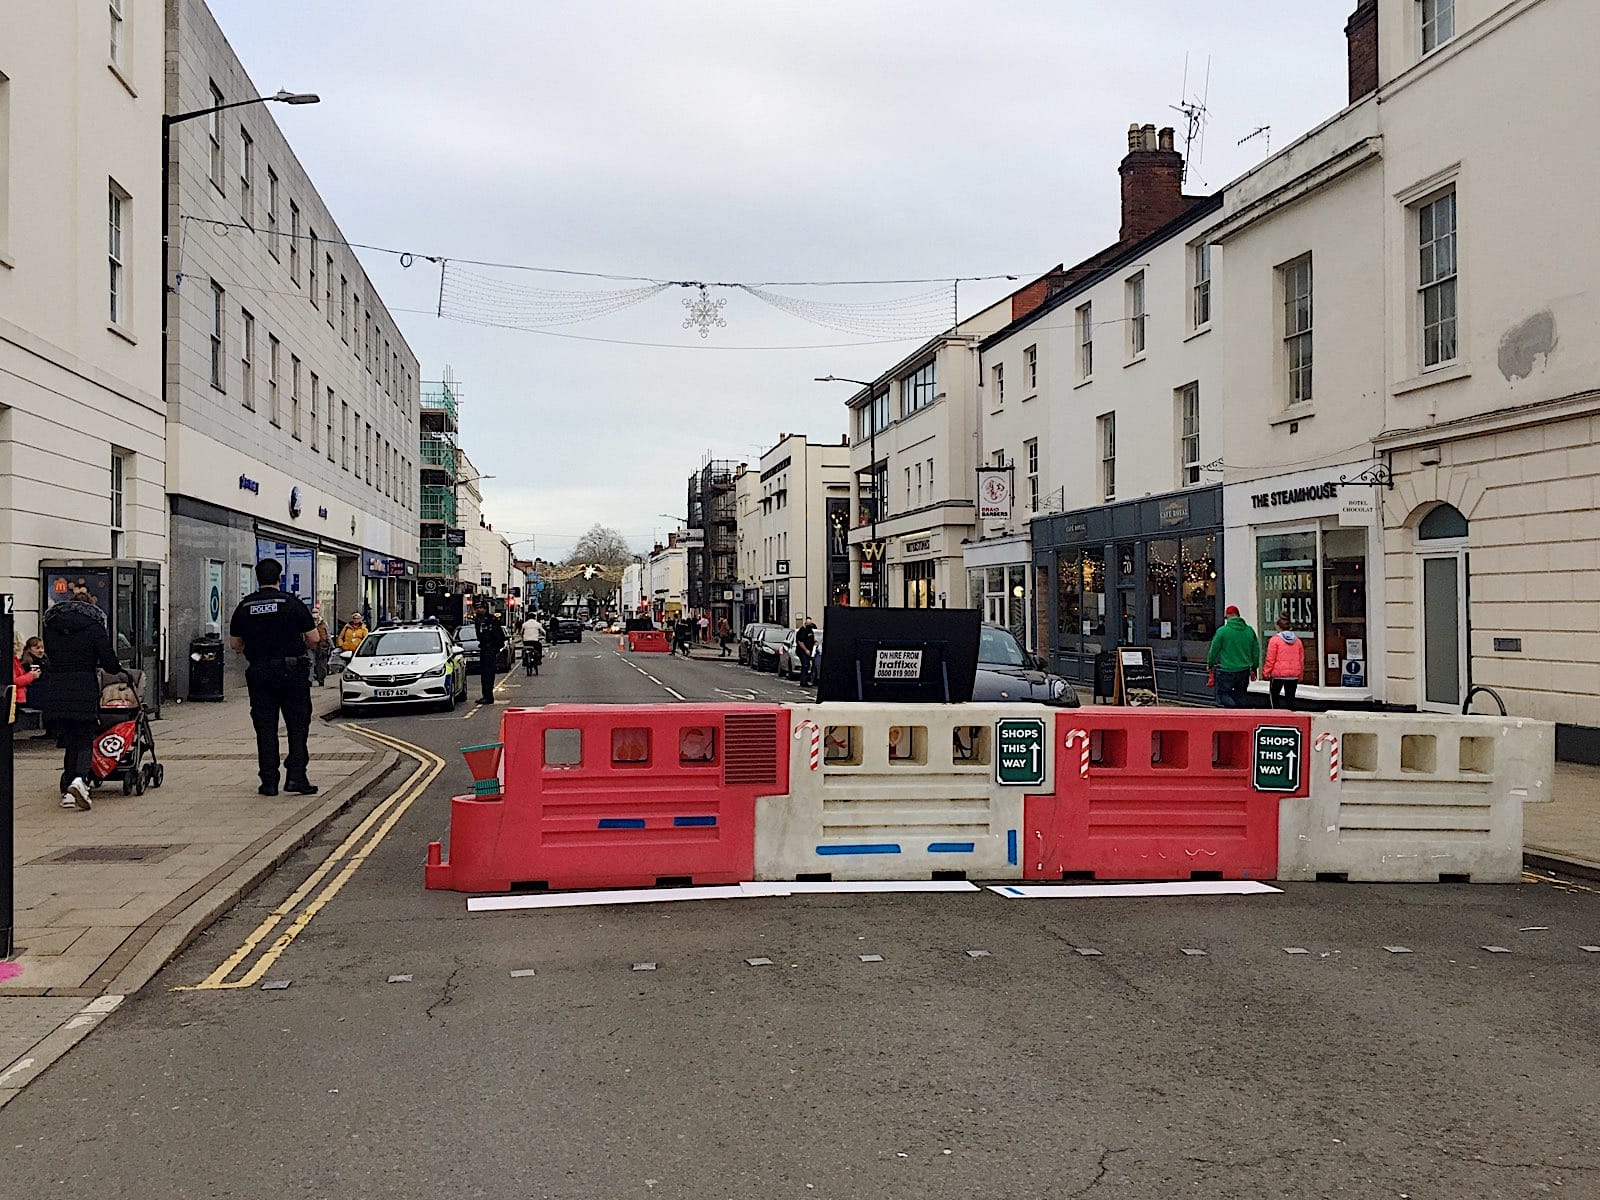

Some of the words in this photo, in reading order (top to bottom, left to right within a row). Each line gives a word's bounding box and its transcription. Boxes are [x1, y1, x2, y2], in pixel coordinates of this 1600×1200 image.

[1251, 493, 1269, 508] THE
[1270, 482, 1338, 506] STEAMHOUSE
[1123, 561, 1131, 574] 70
[1265, 574, 1302, 591] ESPRESSO
[252, 604, 276, 613] POLICE
[880, 651, 888, 659] ON
[889, 651, 902, 659] HIRE
[903, 651, 920, 659] FROM
[369, 660, 420, 668] POLICE
[877, 669, 891, 677] 0800
[892, 669, 903, 677] 819
[903, 669, 918, 677] 9001
[1001, 729, 1038, 738] SHOPS
[1260, 736, 1295, 746] SHOPS
[1001, 744, 1026, 753] THIS
[1259, 751, 1283, 760] THIS
[1002, 759, 1026, 768] WAY
[1259, 765, 1283, 775] WAY
